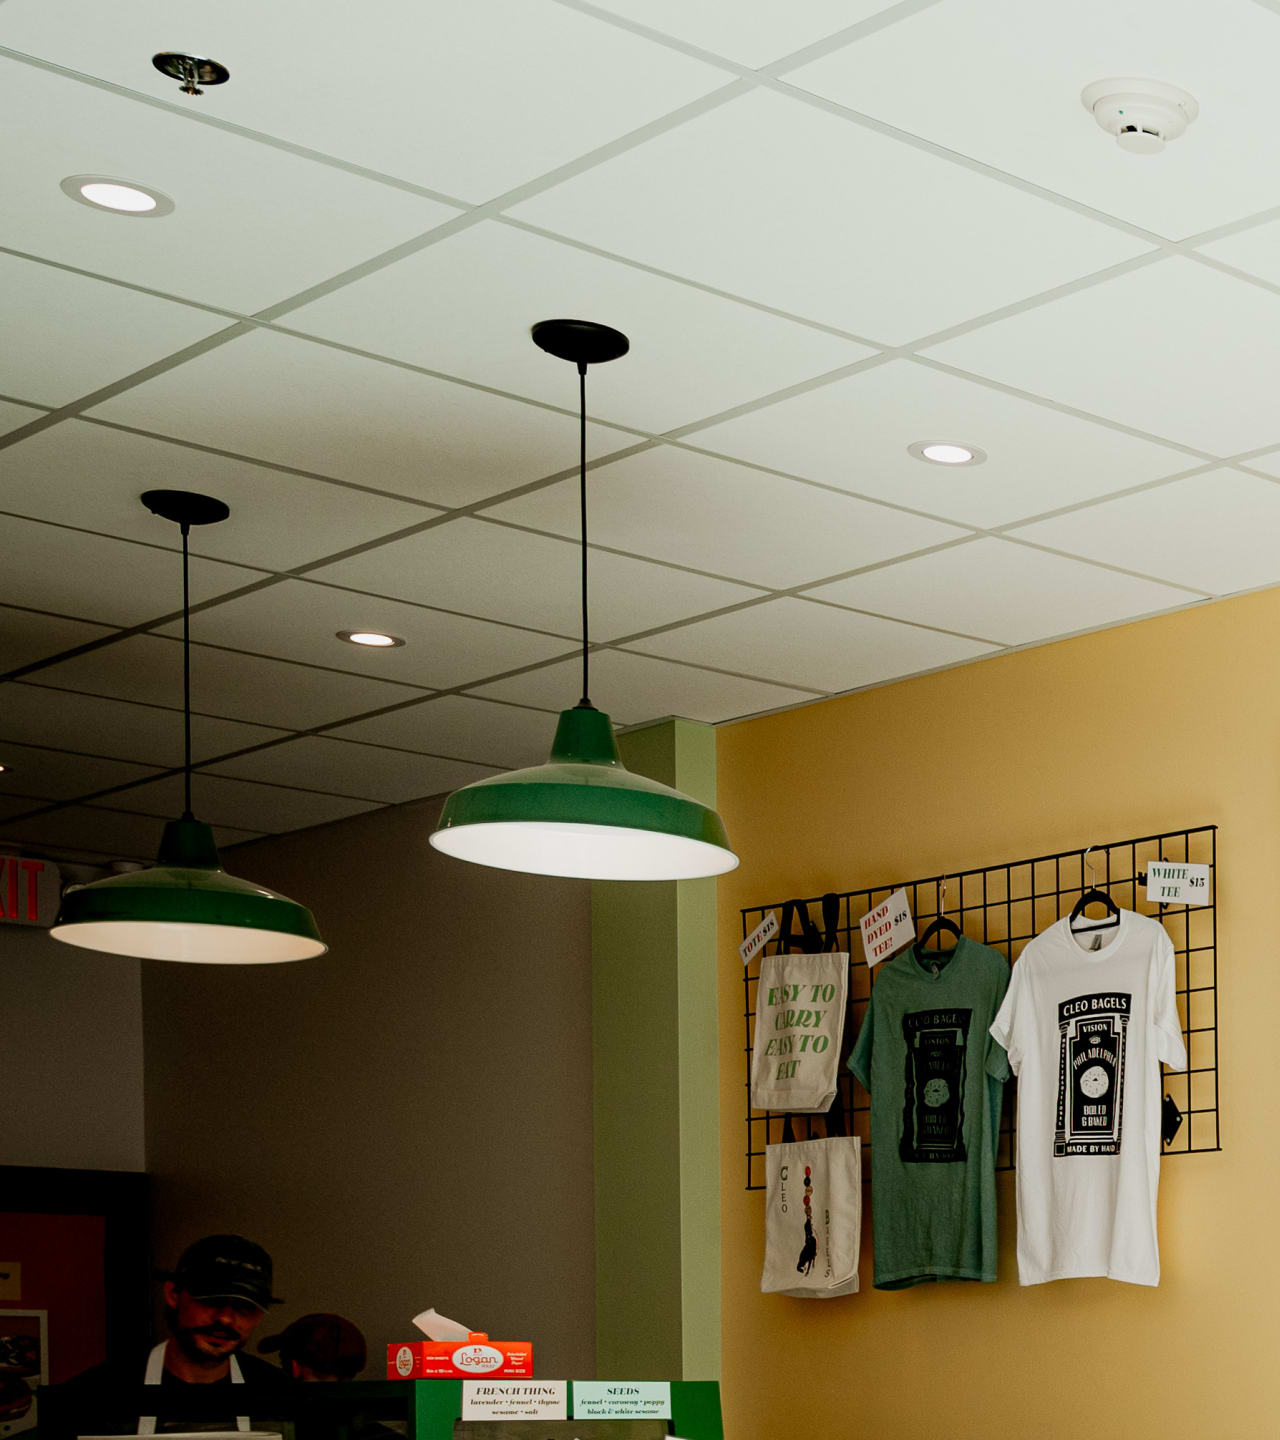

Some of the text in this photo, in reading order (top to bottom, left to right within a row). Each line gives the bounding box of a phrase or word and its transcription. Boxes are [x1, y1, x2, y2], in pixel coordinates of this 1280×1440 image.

[1151, 867, 1188, 881] WHITE
[1159, 884, 1181, 897] TEE
[864, 905, 889, 930] HAND
[867, 921, 892, 945] DYED
[742, 932, 763, 958] TOTE
[872, 938, 894, 958] TEE!
[767, 983, 836, 1007] EASY TO
[1063, 997, 1127, 1017] CLEO BAGELS
[775, 1009, 828, 1032] CARRY
[1082, 1023, 1108, 1033] VISION
[764, 1034, 830, 1057] EASY TO
[775, 1060, 802, 1081] EAT
[459, 1352, 498, 1366] Logan
[607, 1387, 640, 1395] SEEDS
